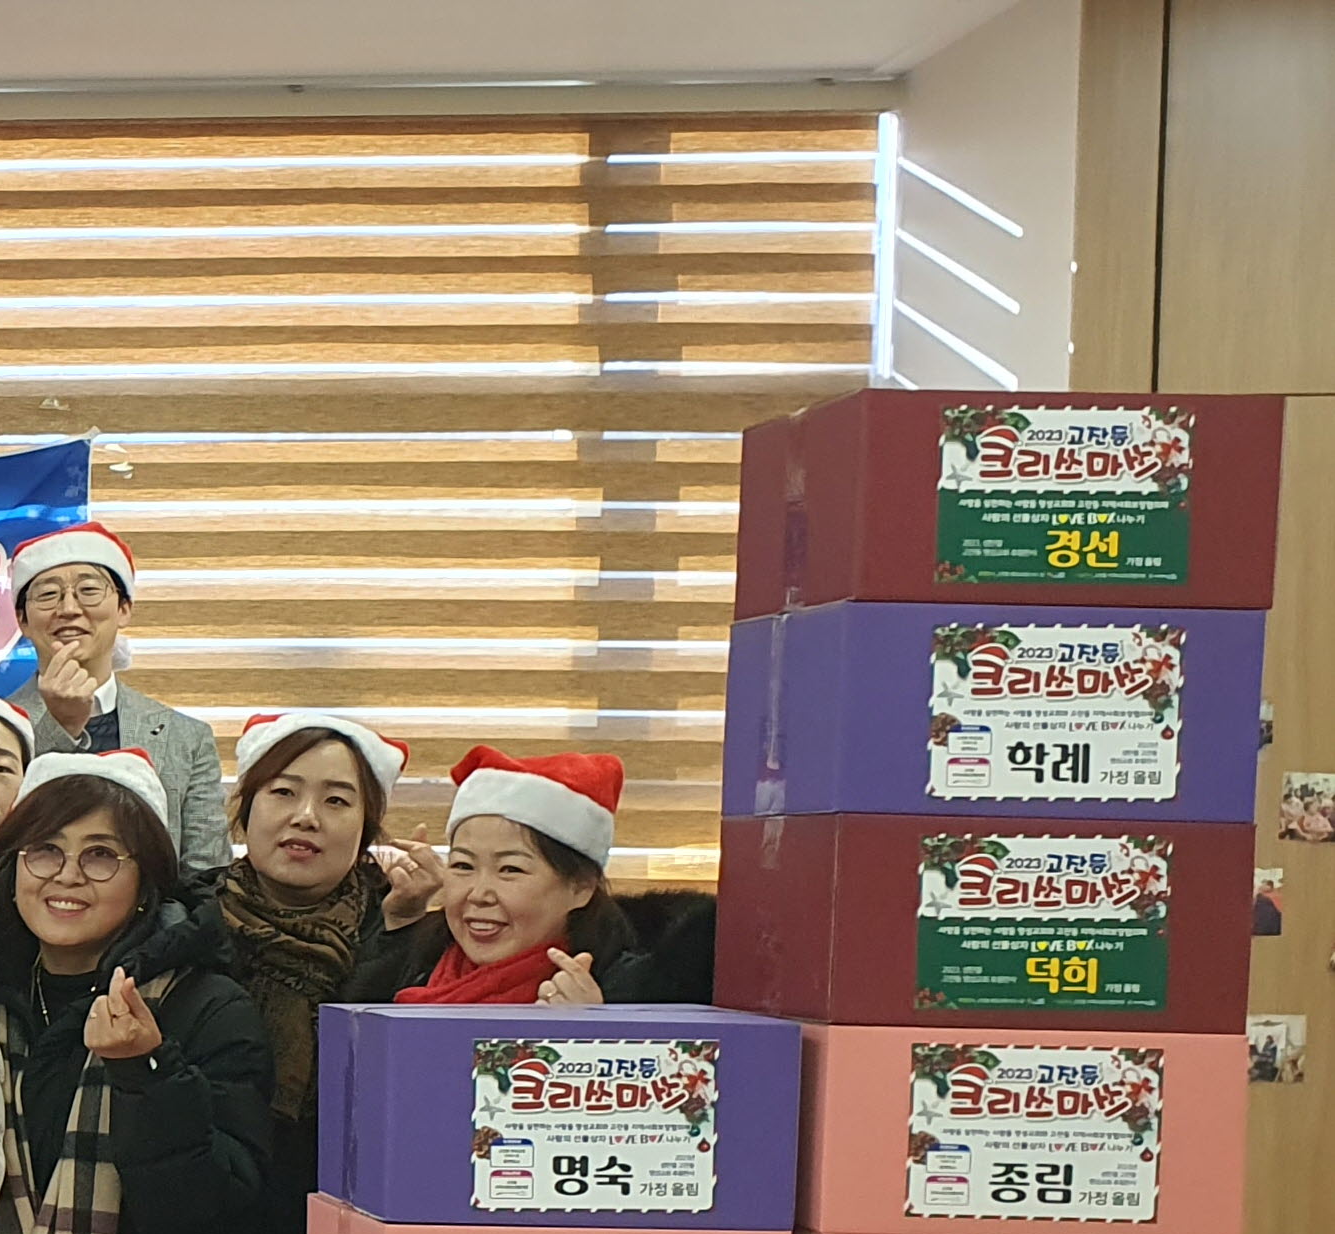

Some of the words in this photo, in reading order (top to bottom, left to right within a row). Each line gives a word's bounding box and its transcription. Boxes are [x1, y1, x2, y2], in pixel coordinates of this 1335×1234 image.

[1047, 531, 1118, 567] 경선
[1017, 647, 1054, 658] 2023
[1058, 642, 1121, 663] 고잔동
[1006, 741, 1090, 783] 학례
[1026, 957, 1097, 993] 덕희
[552, 1155, 633, 1195] 명숙
[989, 1163, 1073, 1203] 종림
